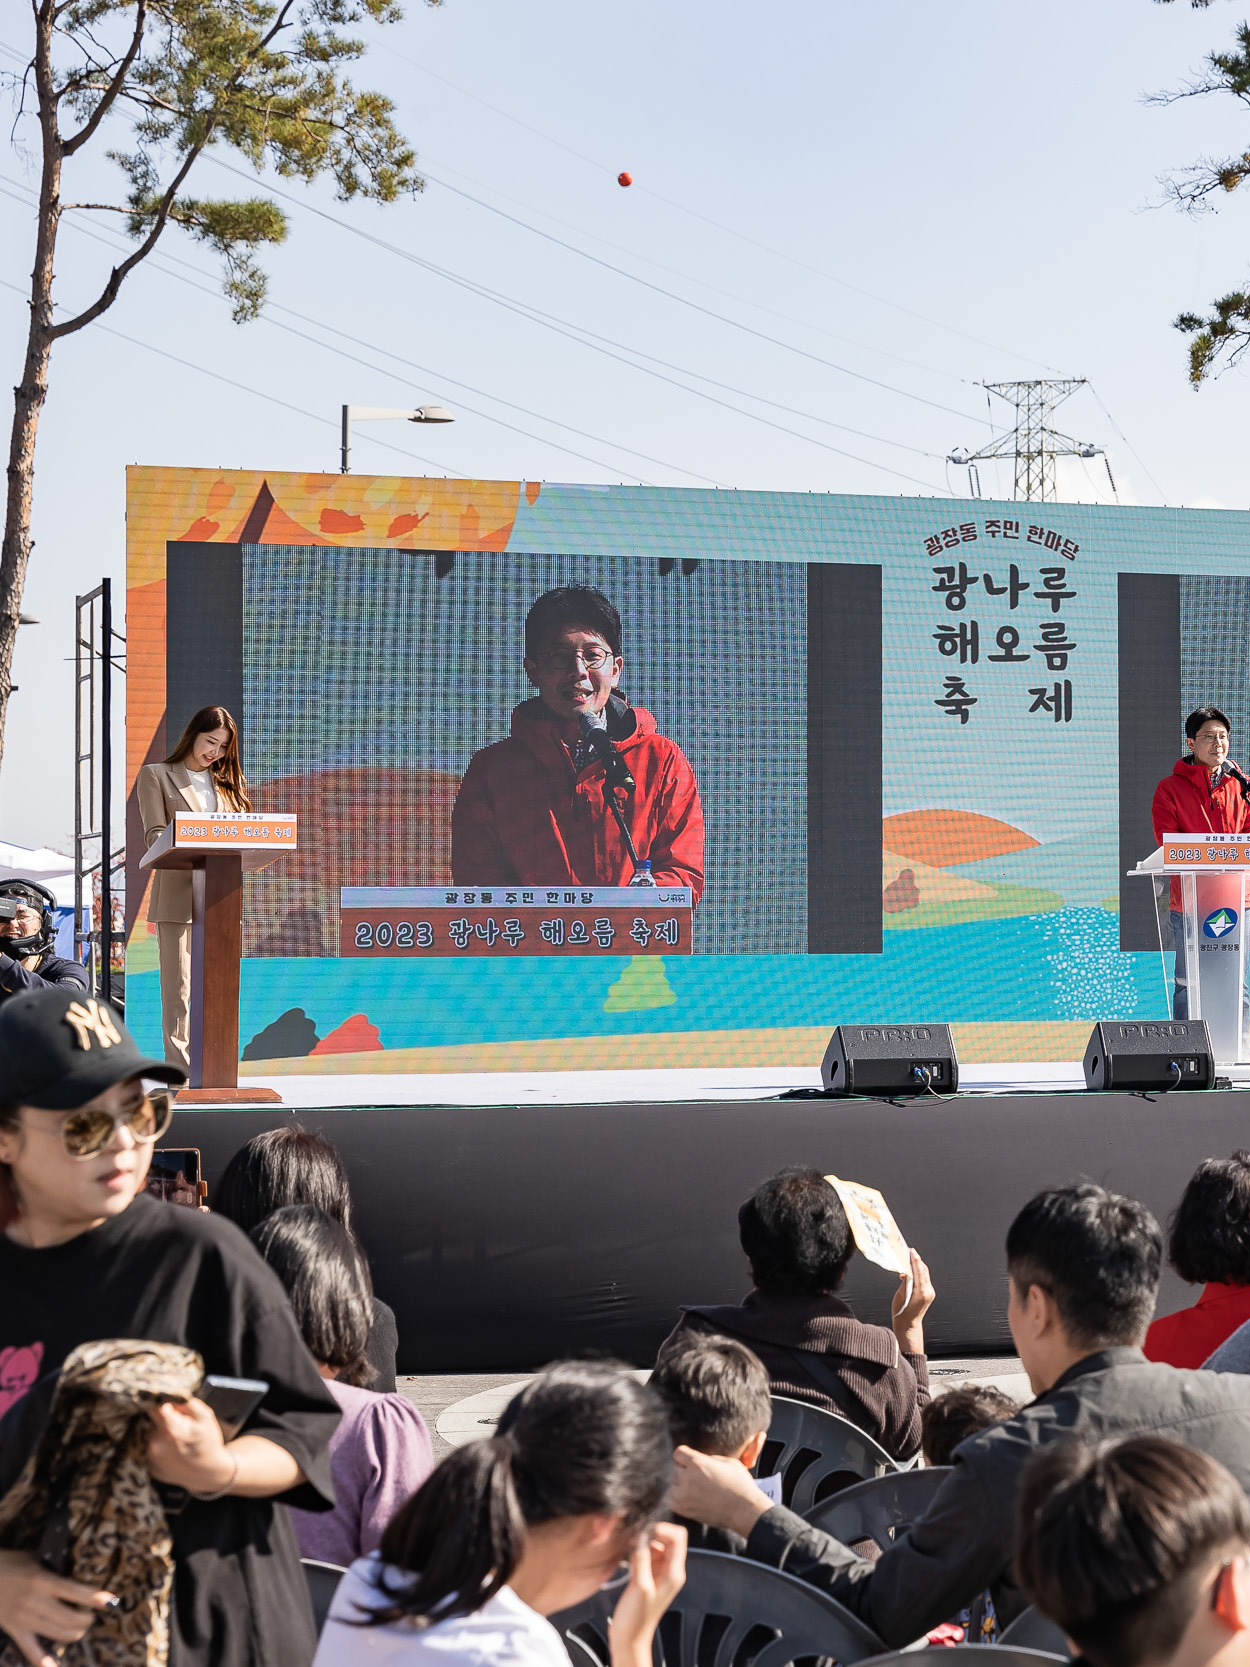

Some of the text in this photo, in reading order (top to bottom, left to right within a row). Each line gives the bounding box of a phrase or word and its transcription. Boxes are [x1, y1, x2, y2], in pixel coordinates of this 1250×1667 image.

[923, 520, 1080, 562] 광장동 주민 한마당
[931, 562, 1077, 613] 광나루
[932, 620, 1077, 671] 해오름
[180, 826, 208, 836] 2023
[1168, 848, 1201, 860] 2023
[1206, 847, 1238, 861] 광나루
[445, 892, 594, 904] 광장동 주민 한마당
[354, 916, 678, 948] 2023 광나루 해오름 축제
[65, 998, 122, 1052] NY
